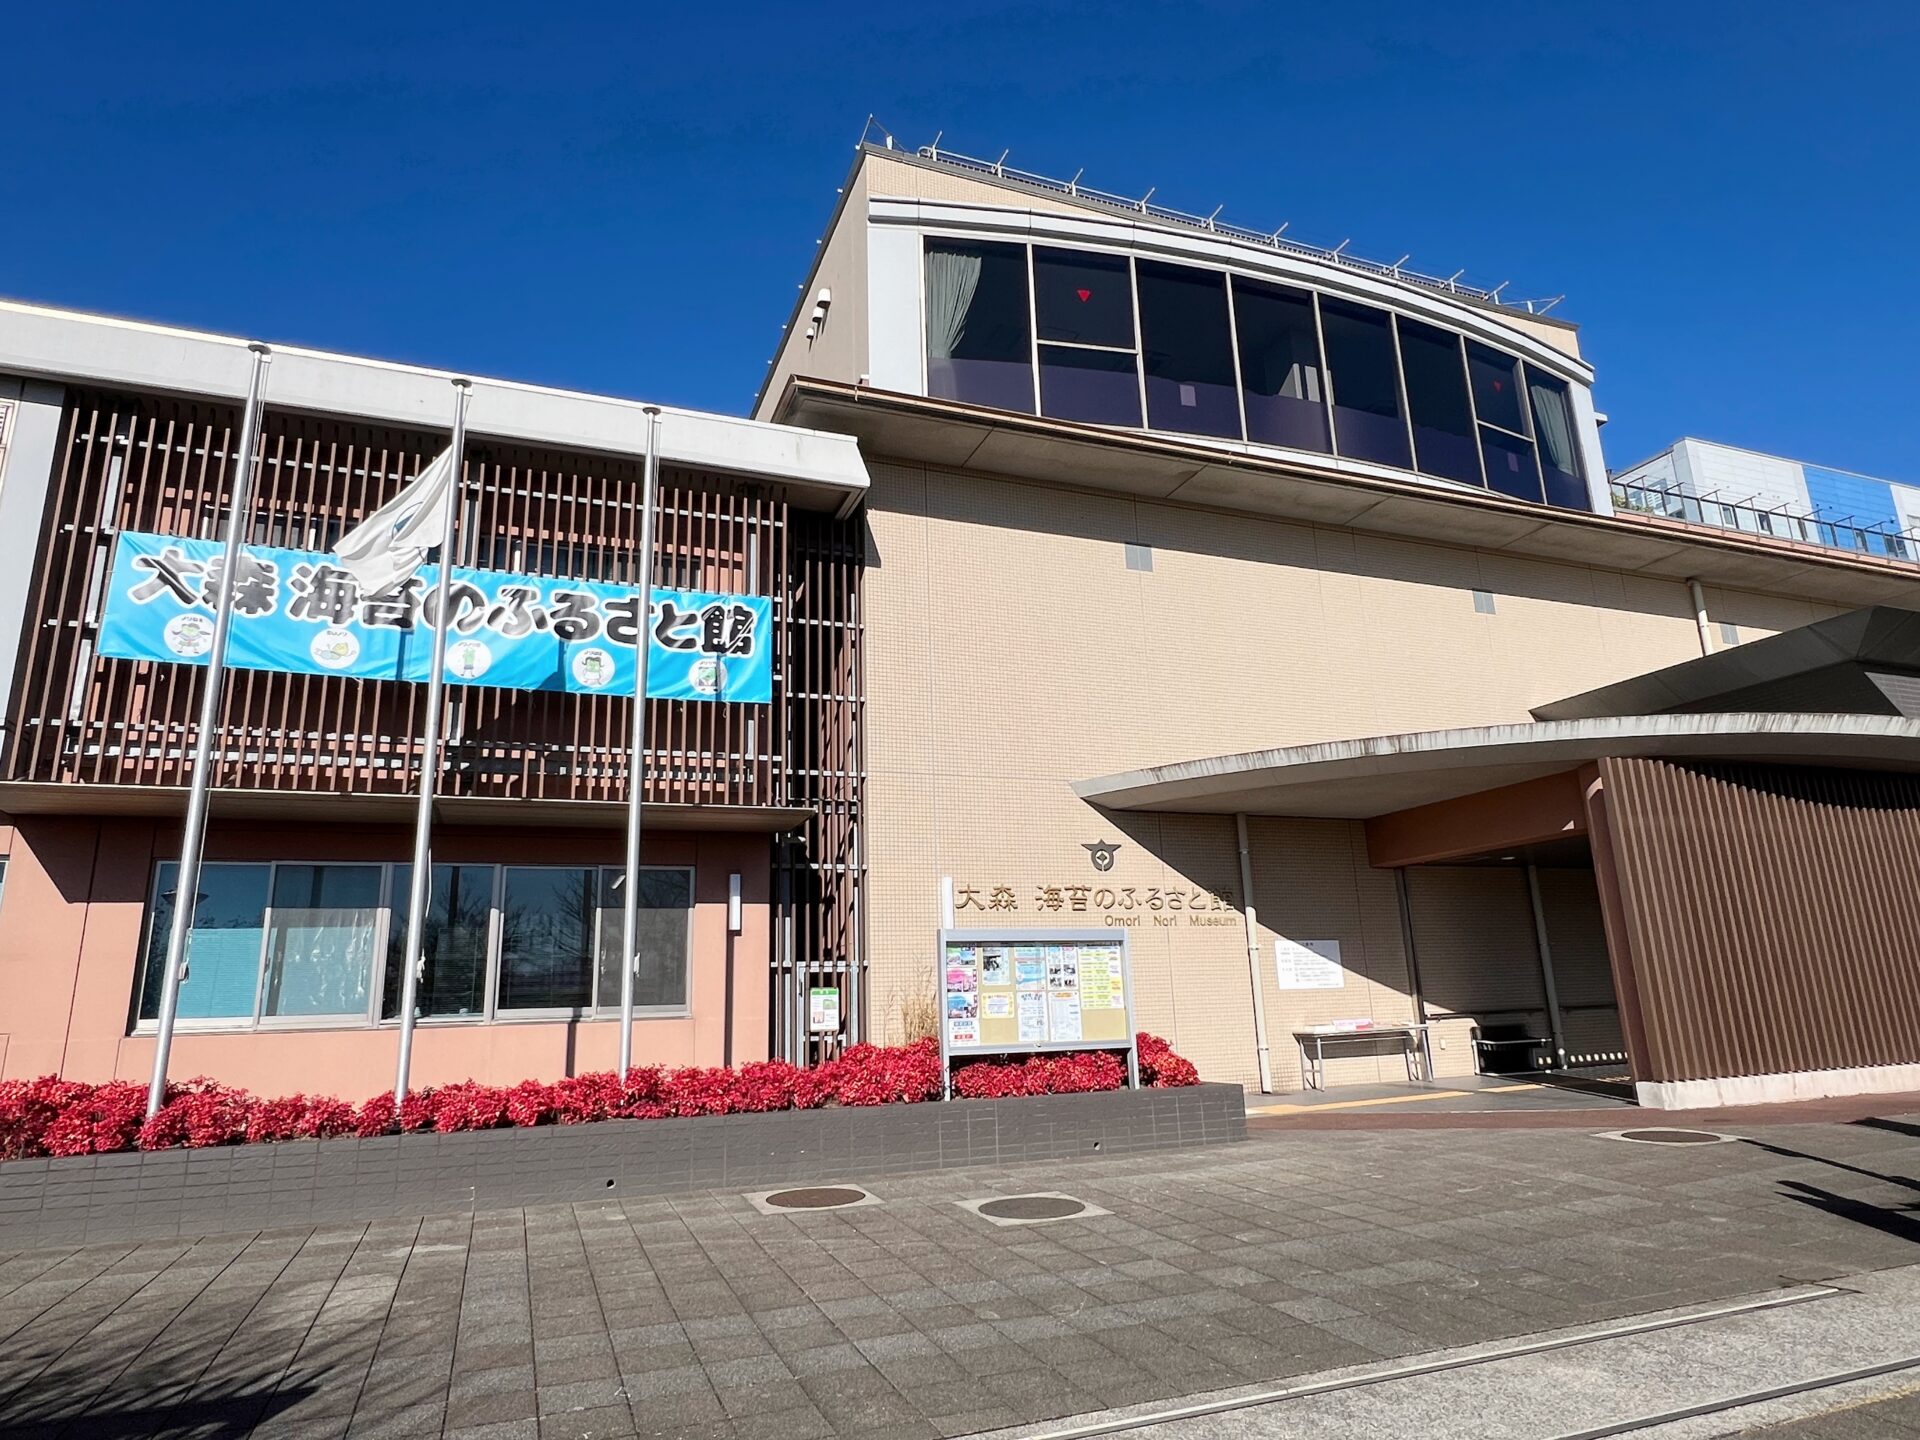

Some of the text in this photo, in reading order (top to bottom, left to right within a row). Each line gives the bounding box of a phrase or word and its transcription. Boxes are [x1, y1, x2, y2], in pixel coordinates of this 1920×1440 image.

[131, 548, 278, 615] 大森
[956, 884, 1235, 912] 大森 海苔のふるさと館
[1104, 915, 1237, 927] Omori Nori Museum
